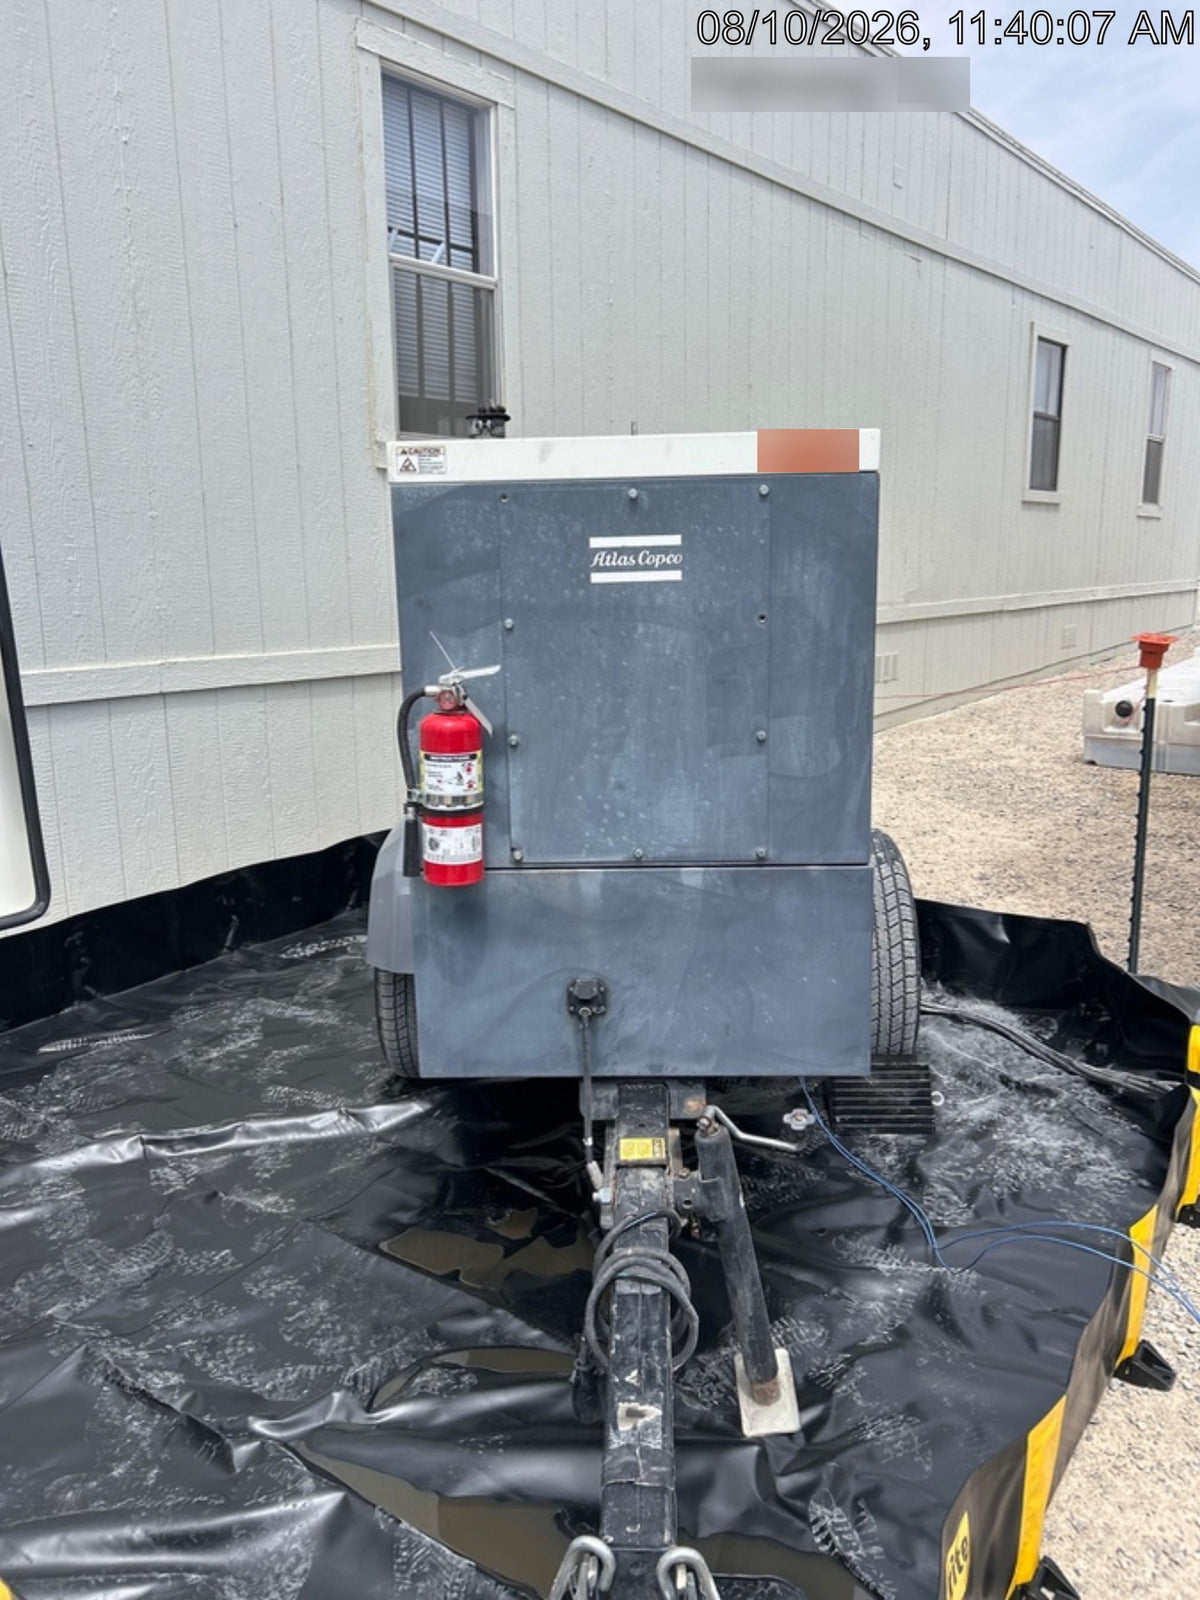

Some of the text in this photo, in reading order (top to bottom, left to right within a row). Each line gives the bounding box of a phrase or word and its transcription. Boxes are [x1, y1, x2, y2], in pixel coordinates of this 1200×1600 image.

[408, 447, 441, 455] CAUTION
[590, 549, 683, 568] Atlas Copco
